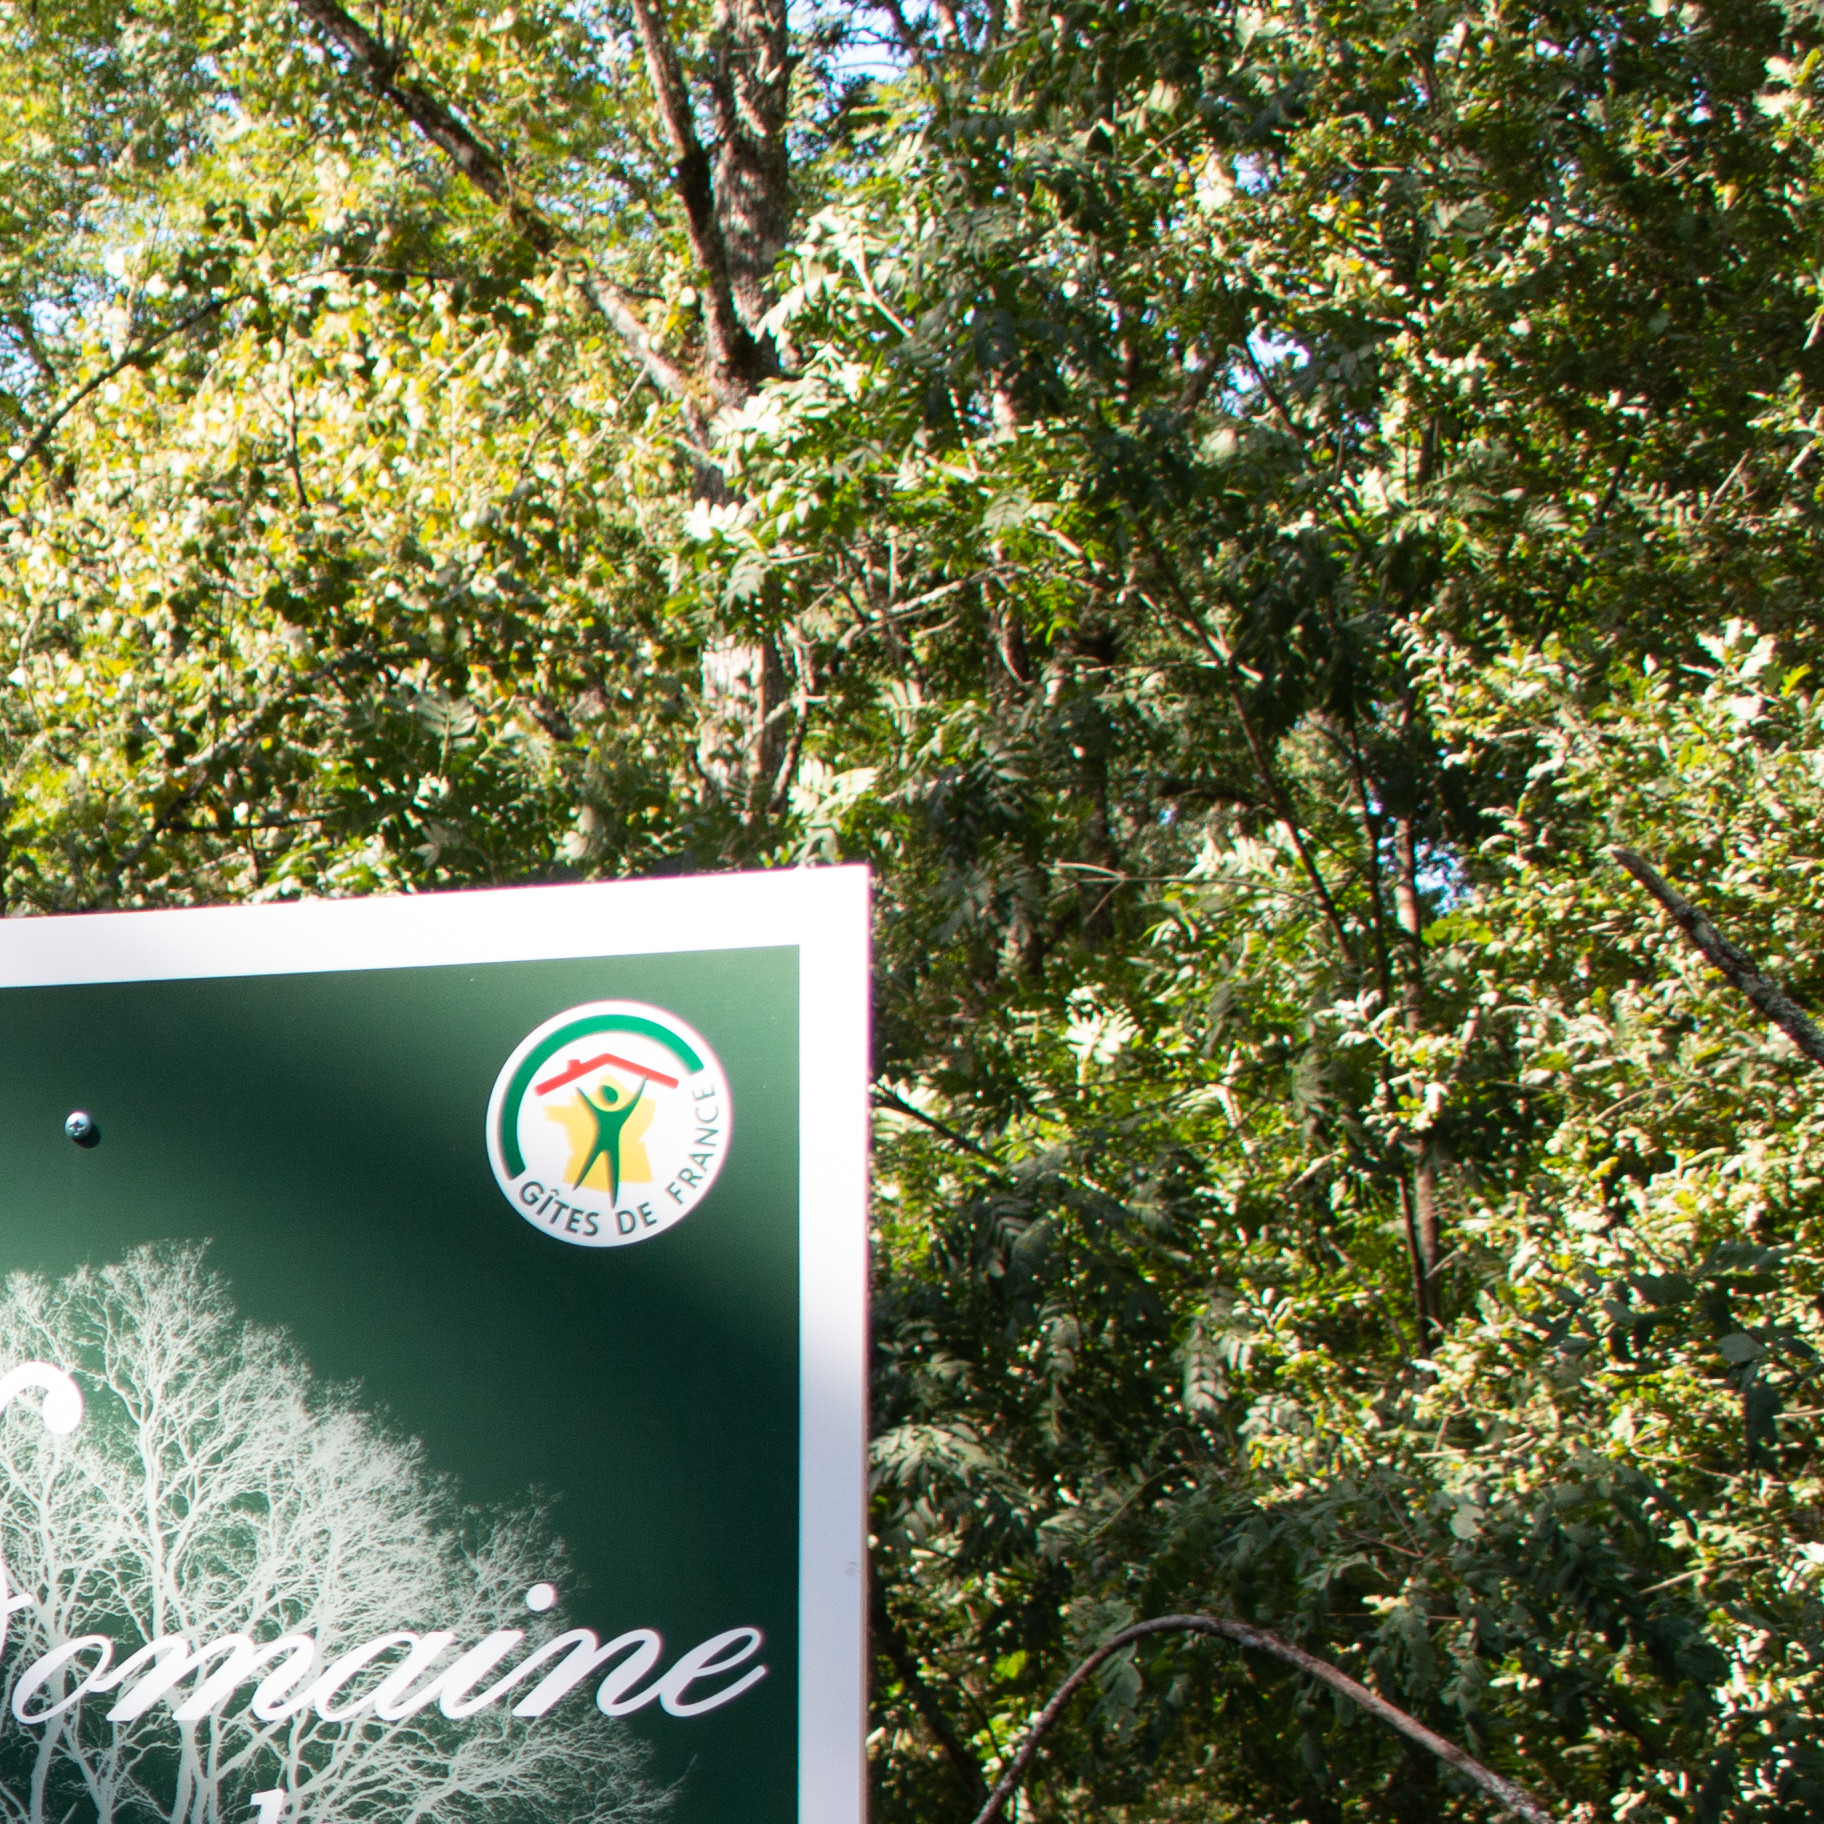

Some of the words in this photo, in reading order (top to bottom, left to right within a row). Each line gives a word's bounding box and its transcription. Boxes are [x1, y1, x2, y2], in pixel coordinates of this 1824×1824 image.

[519, 1180, 599, 1238] GÎTES
[614, 1201, 658, 1236] DE
[663, 1084, 719, 1206] FRANCE
